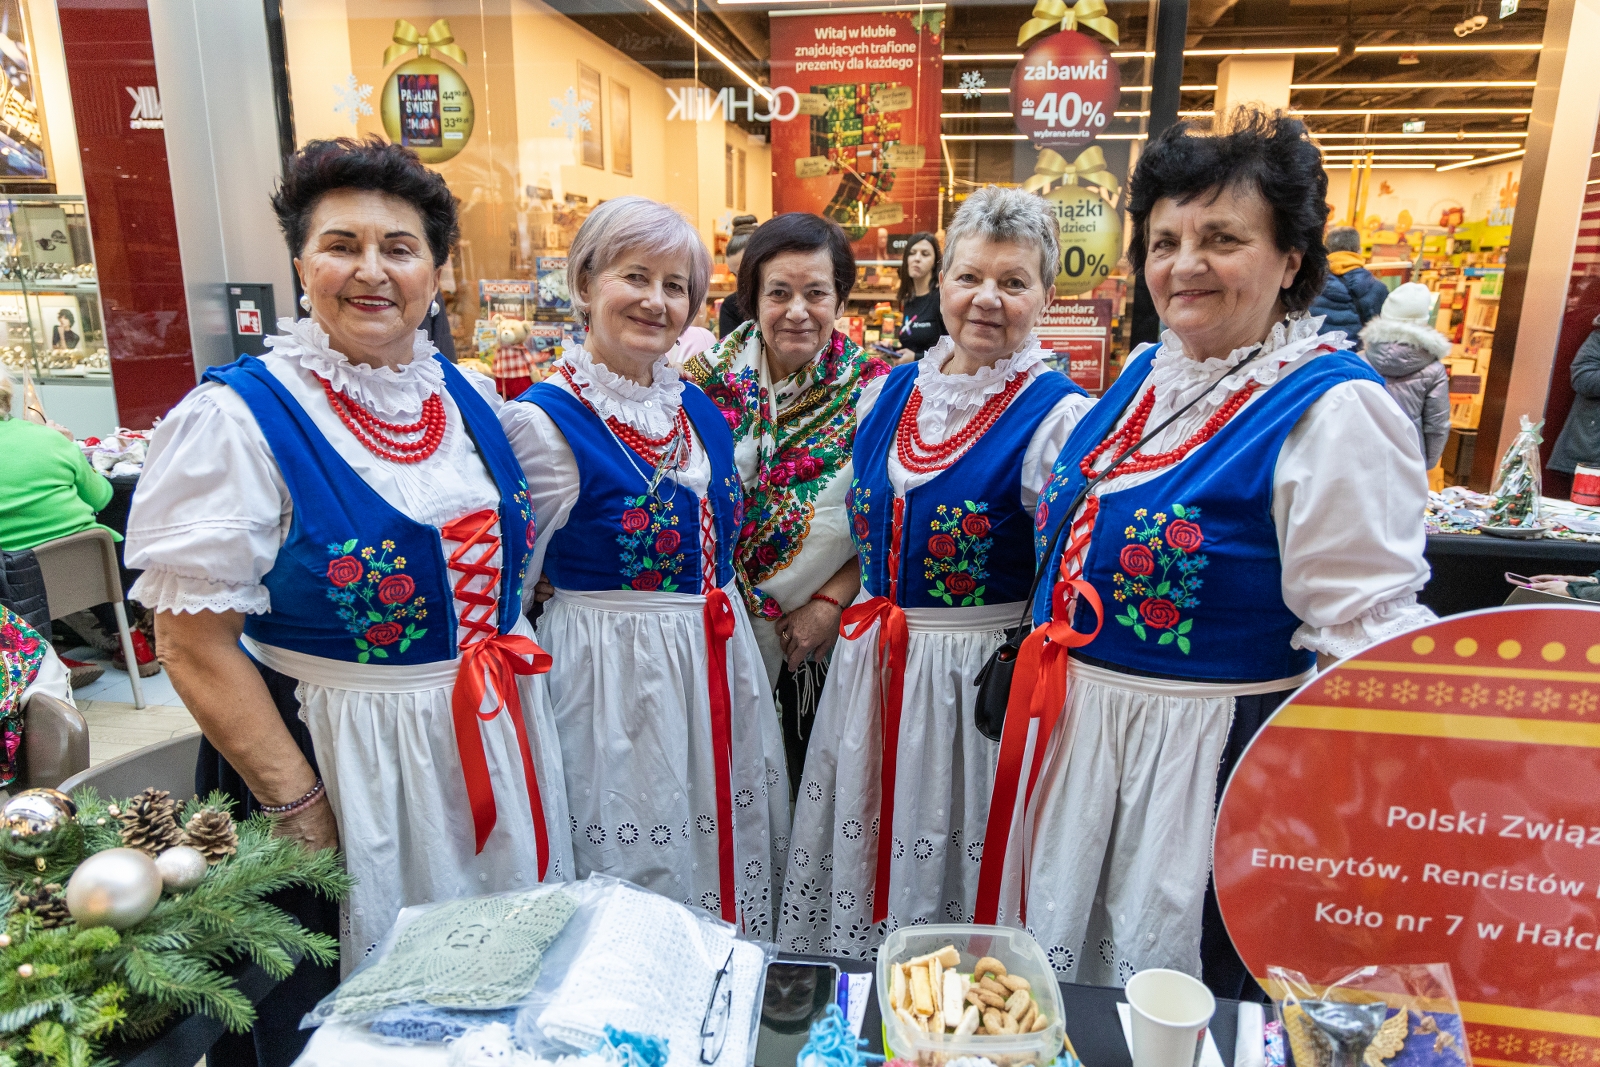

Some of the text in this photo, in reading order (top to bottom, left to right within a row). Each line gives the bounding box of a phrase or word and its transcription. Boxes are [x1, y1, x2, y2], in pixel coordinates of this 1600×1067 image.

[815, 24, 897, 41] Witaj w klubie
[794, 40, 917, 58] znajdujących trafione
[795, 55, 914, 74] prezenty dla każdego
[1023, 59, 1108, 81] zabawki
[400, 89, 438, 102] PAULINA
[1022, 97, 1035, 108] do
[1033, 128, 1090, 139] wybrana oferta
[1061, 220, 1097, 233] dzieci
[483, 284, 531, 293] MONOPOLY
[493, 303, 522, 312] TATRY
[1386, 805, 1488, 835] Polski
[1250, 847, 1409, 884] Emerytów,
[1421, 862, 1586, 897] Rencistów
[1314, 901, 1384, 929] Koło
[1395, 913, 1433, 934] nr
[1444, 914, 1464, 936] 7
[1476, 921, 1504, 941] w
